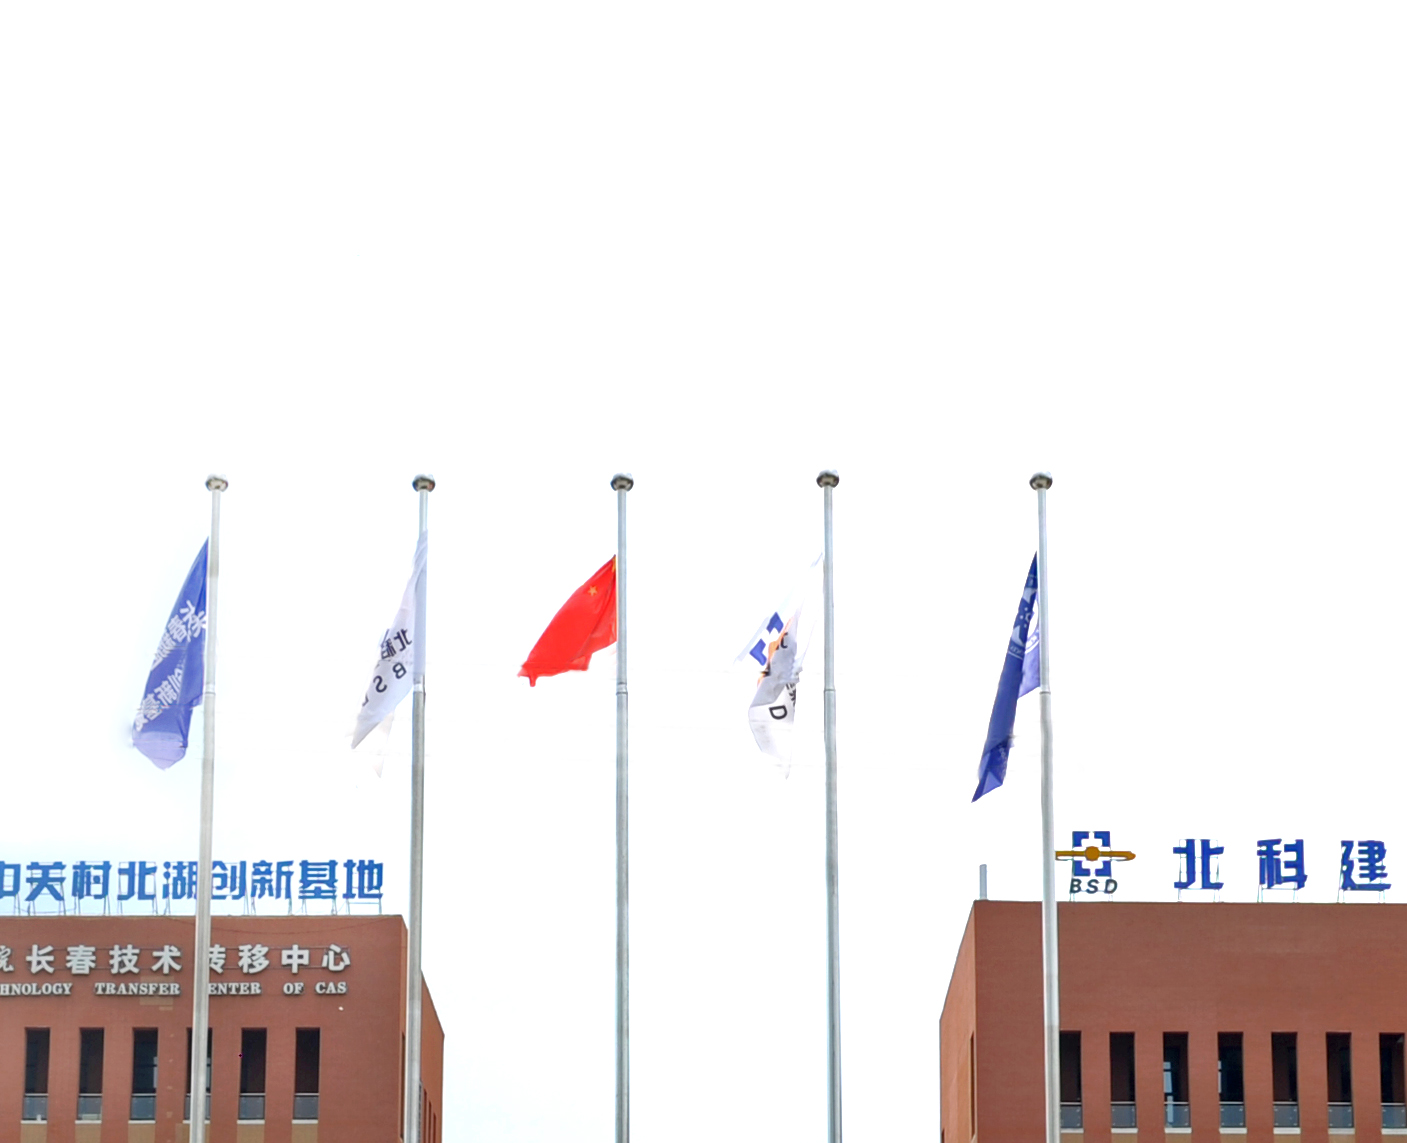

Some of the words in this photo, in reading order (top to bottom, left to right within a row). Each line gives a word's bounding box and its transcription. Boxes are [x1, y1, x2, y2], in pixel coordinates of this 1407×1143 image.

[1069, 878, 1118, 894] BSD
[95, 982, 181, 995] TRANSFER
[208, 982, 262, 995] ENTER
[283, 982, 304, 995] OF
[315, 981, 347, 994] CAS
